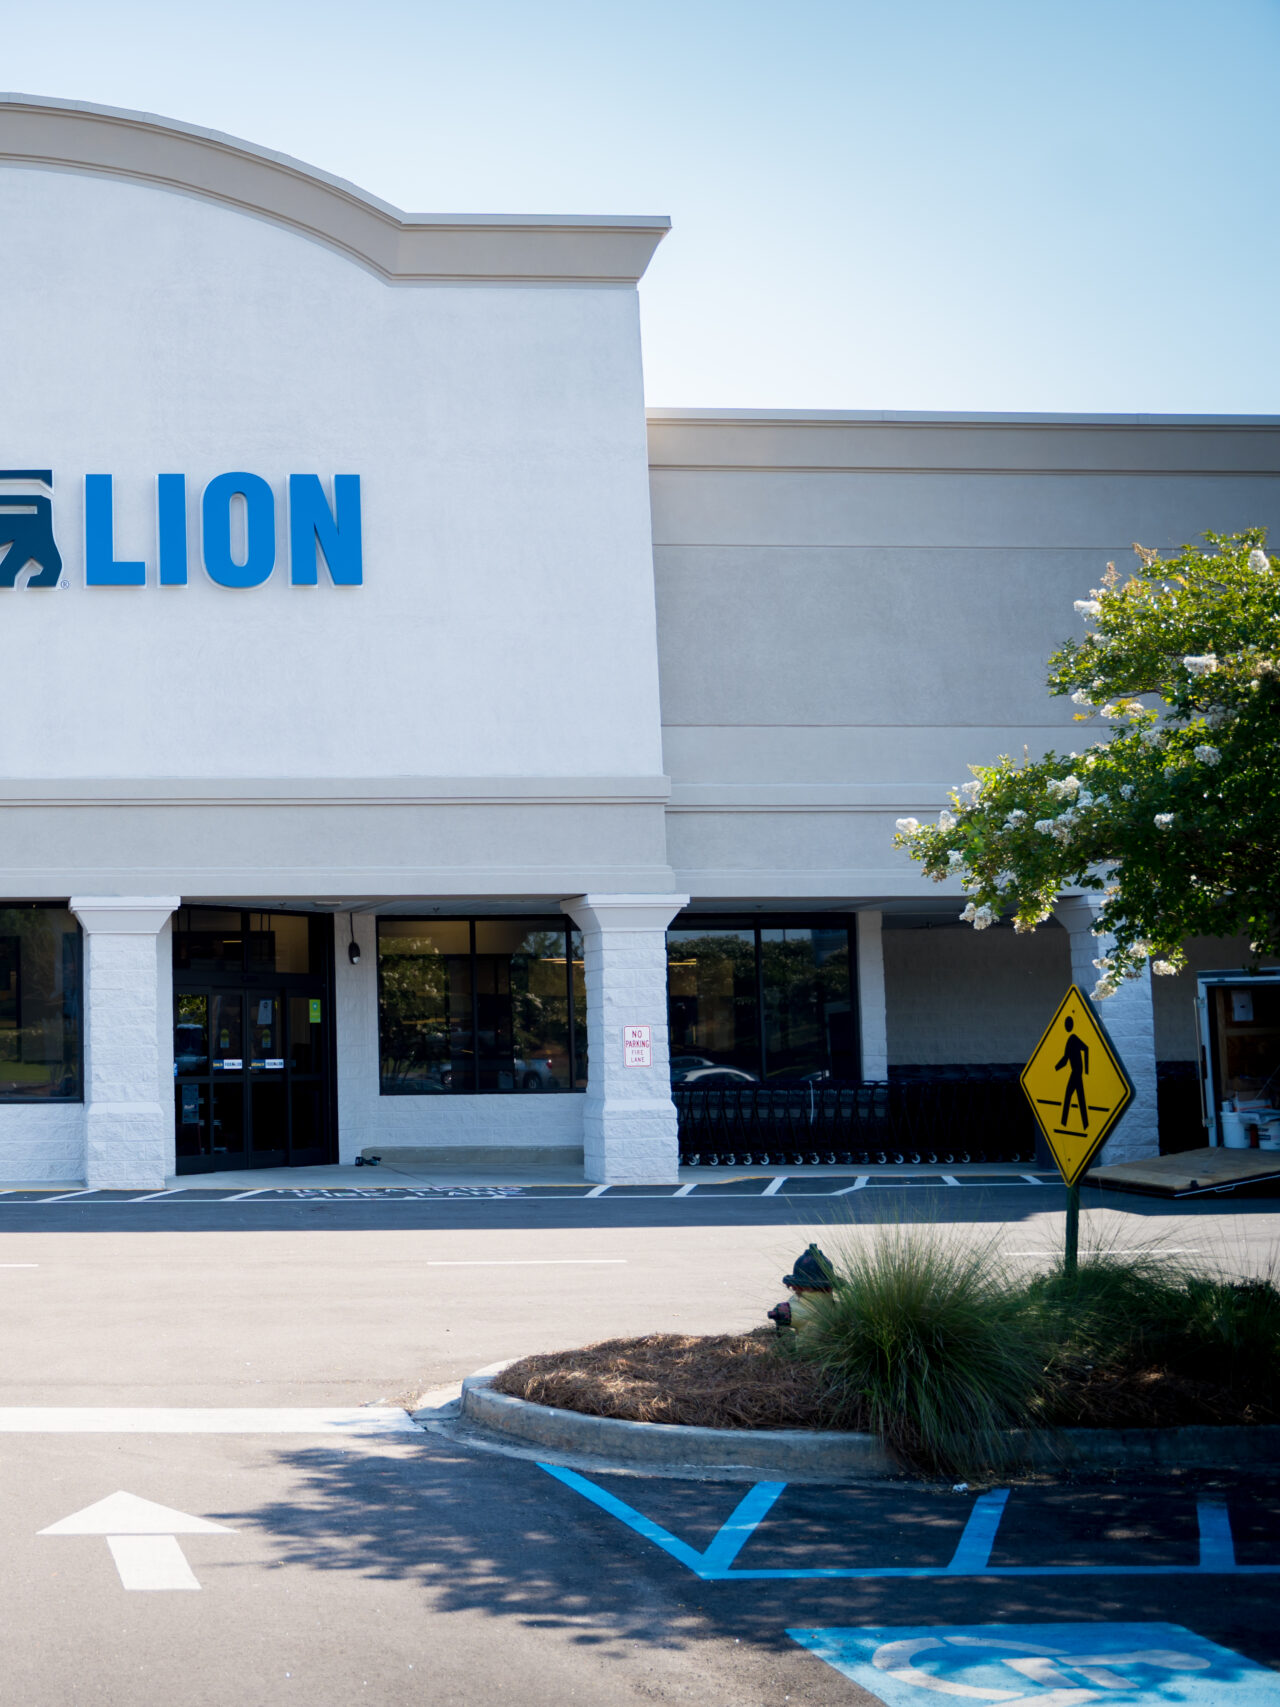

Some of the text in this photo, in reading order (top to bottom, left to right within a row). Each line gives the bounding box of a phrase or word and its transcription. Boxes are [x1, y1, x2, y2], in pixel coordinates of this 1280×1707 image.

[84, 472, 363, 587] LION
[631, 1030, 643, 1038] NO
[625, 1040, 650, 1048] PARKING
